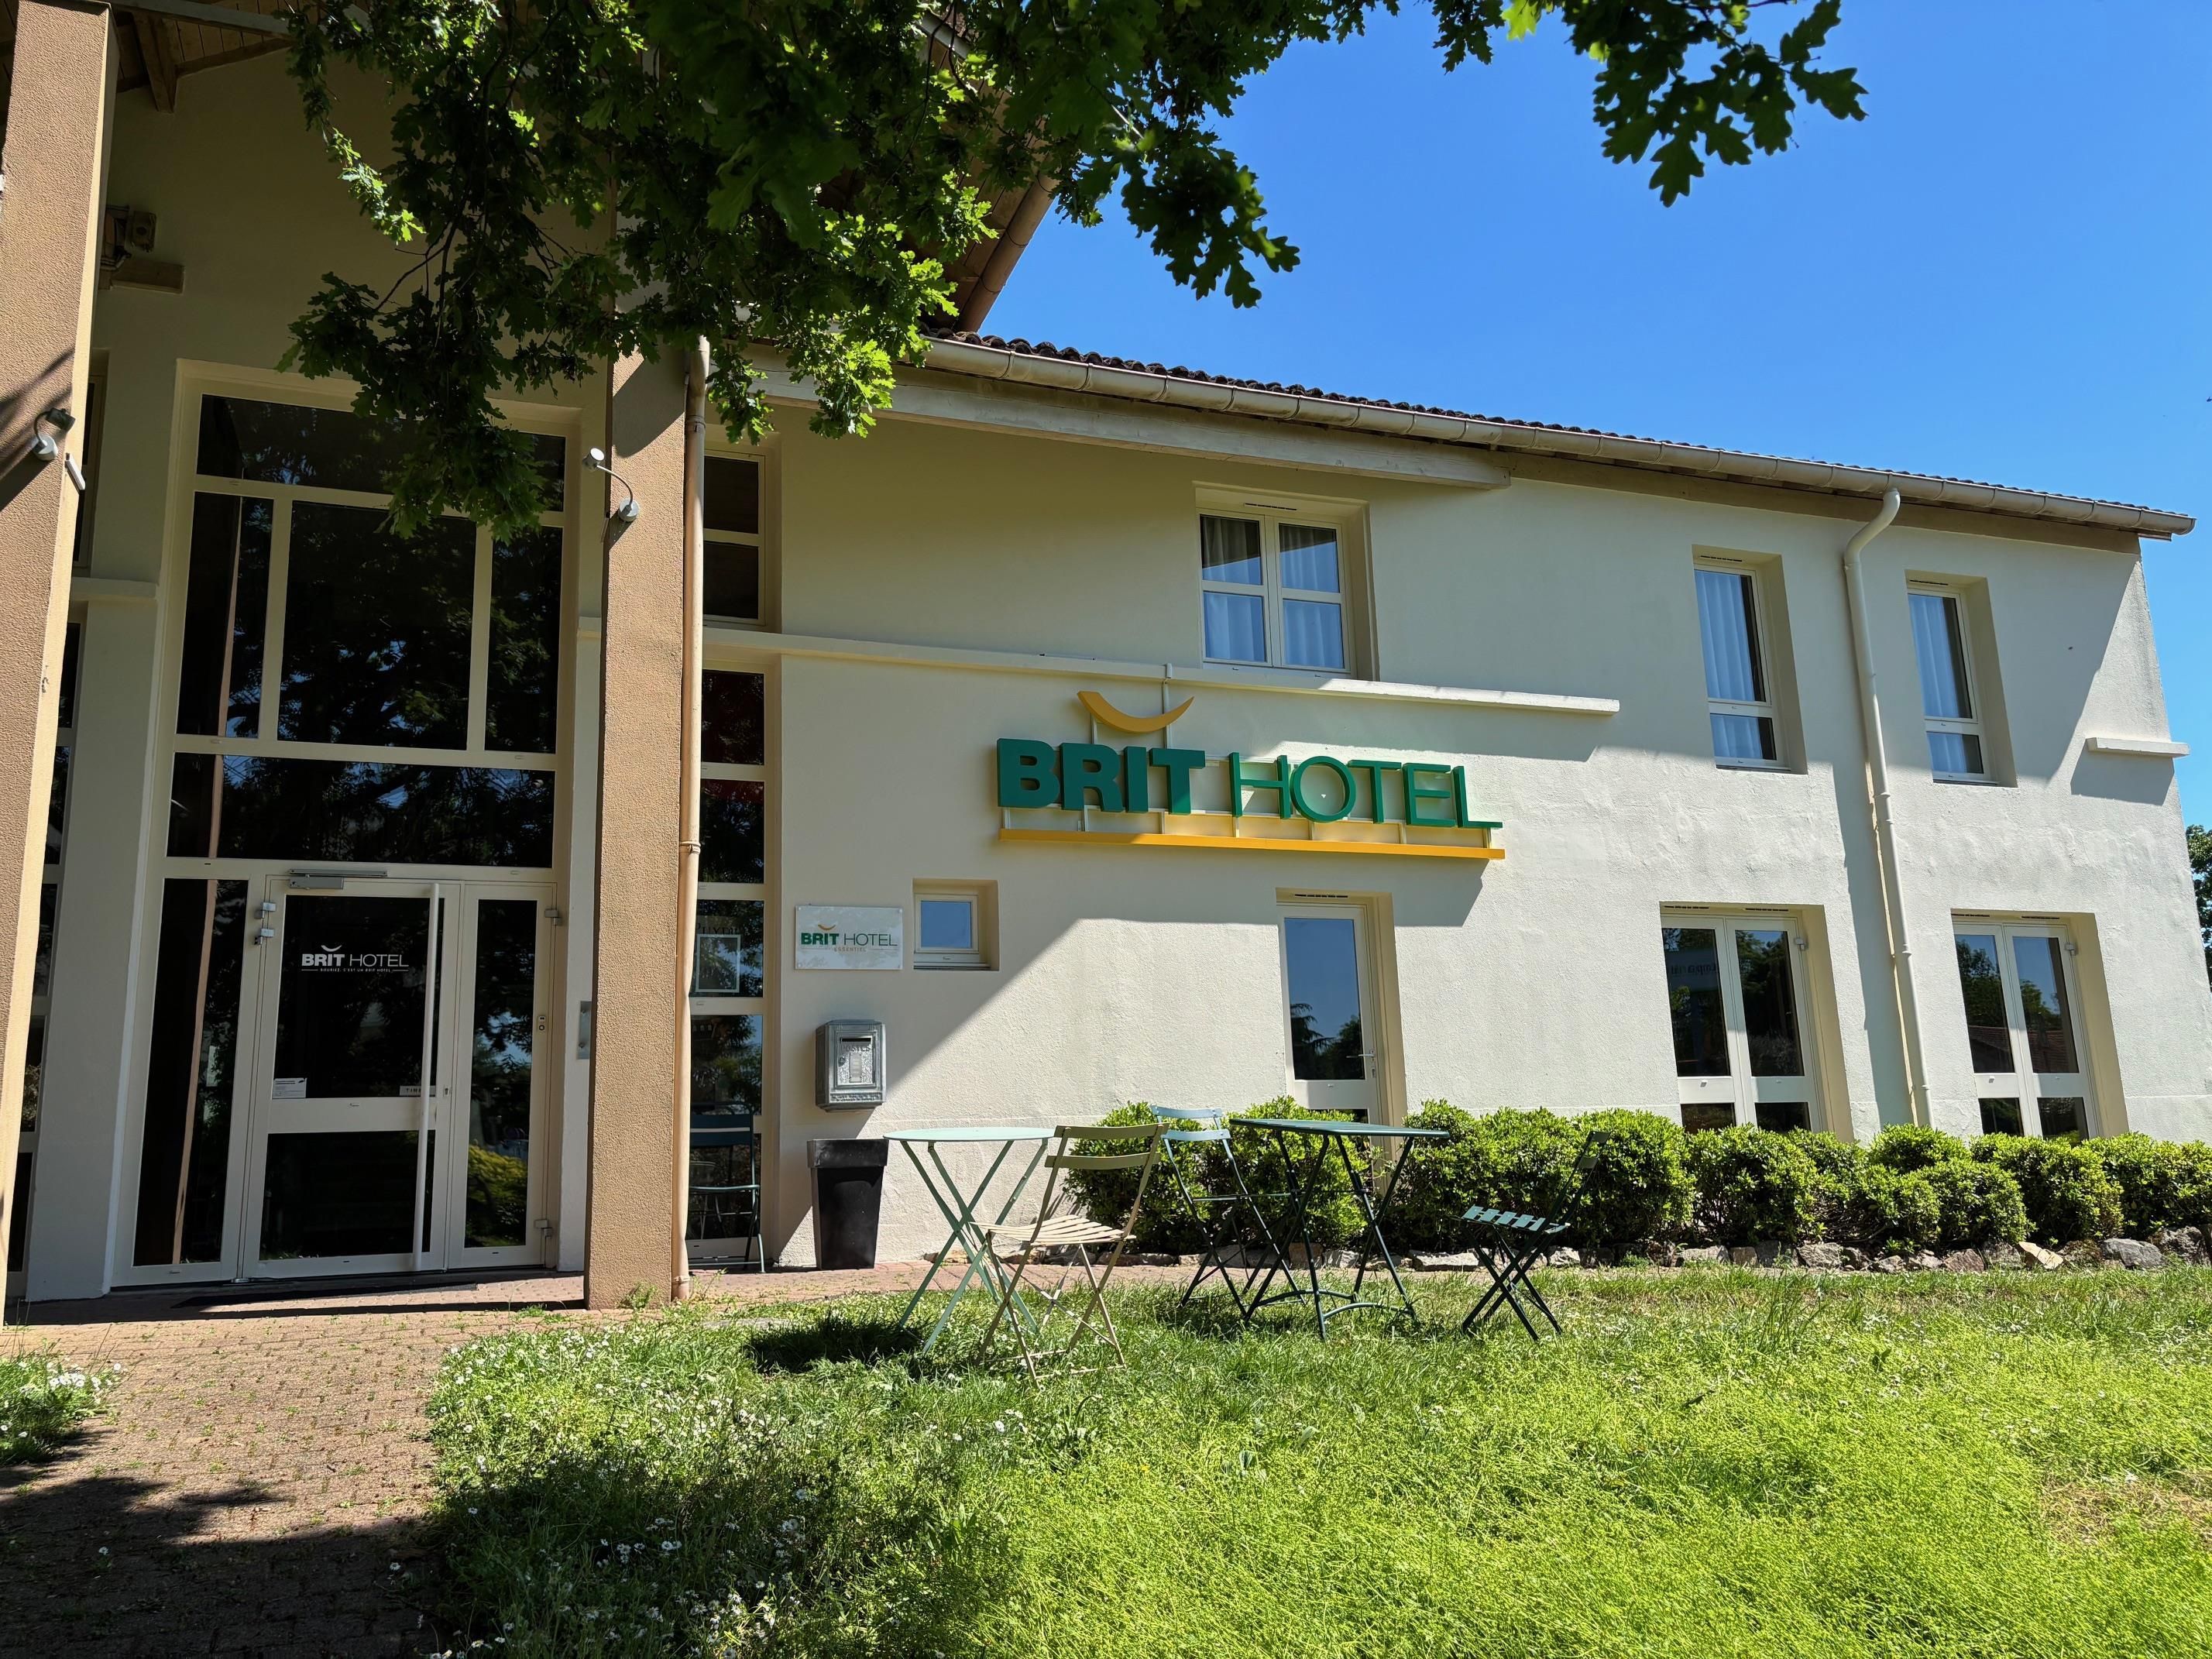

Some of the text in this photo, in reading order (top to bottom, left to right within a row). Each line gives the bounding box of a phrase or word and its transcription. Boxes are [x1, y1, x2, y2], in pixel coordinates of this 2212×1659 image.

[997, 738, 1503, 829] BRIT HOTEL
[801, 933, 898, 946] BRIT HOTEL
[301, 953, 409, 967] BRIT HOTEL
